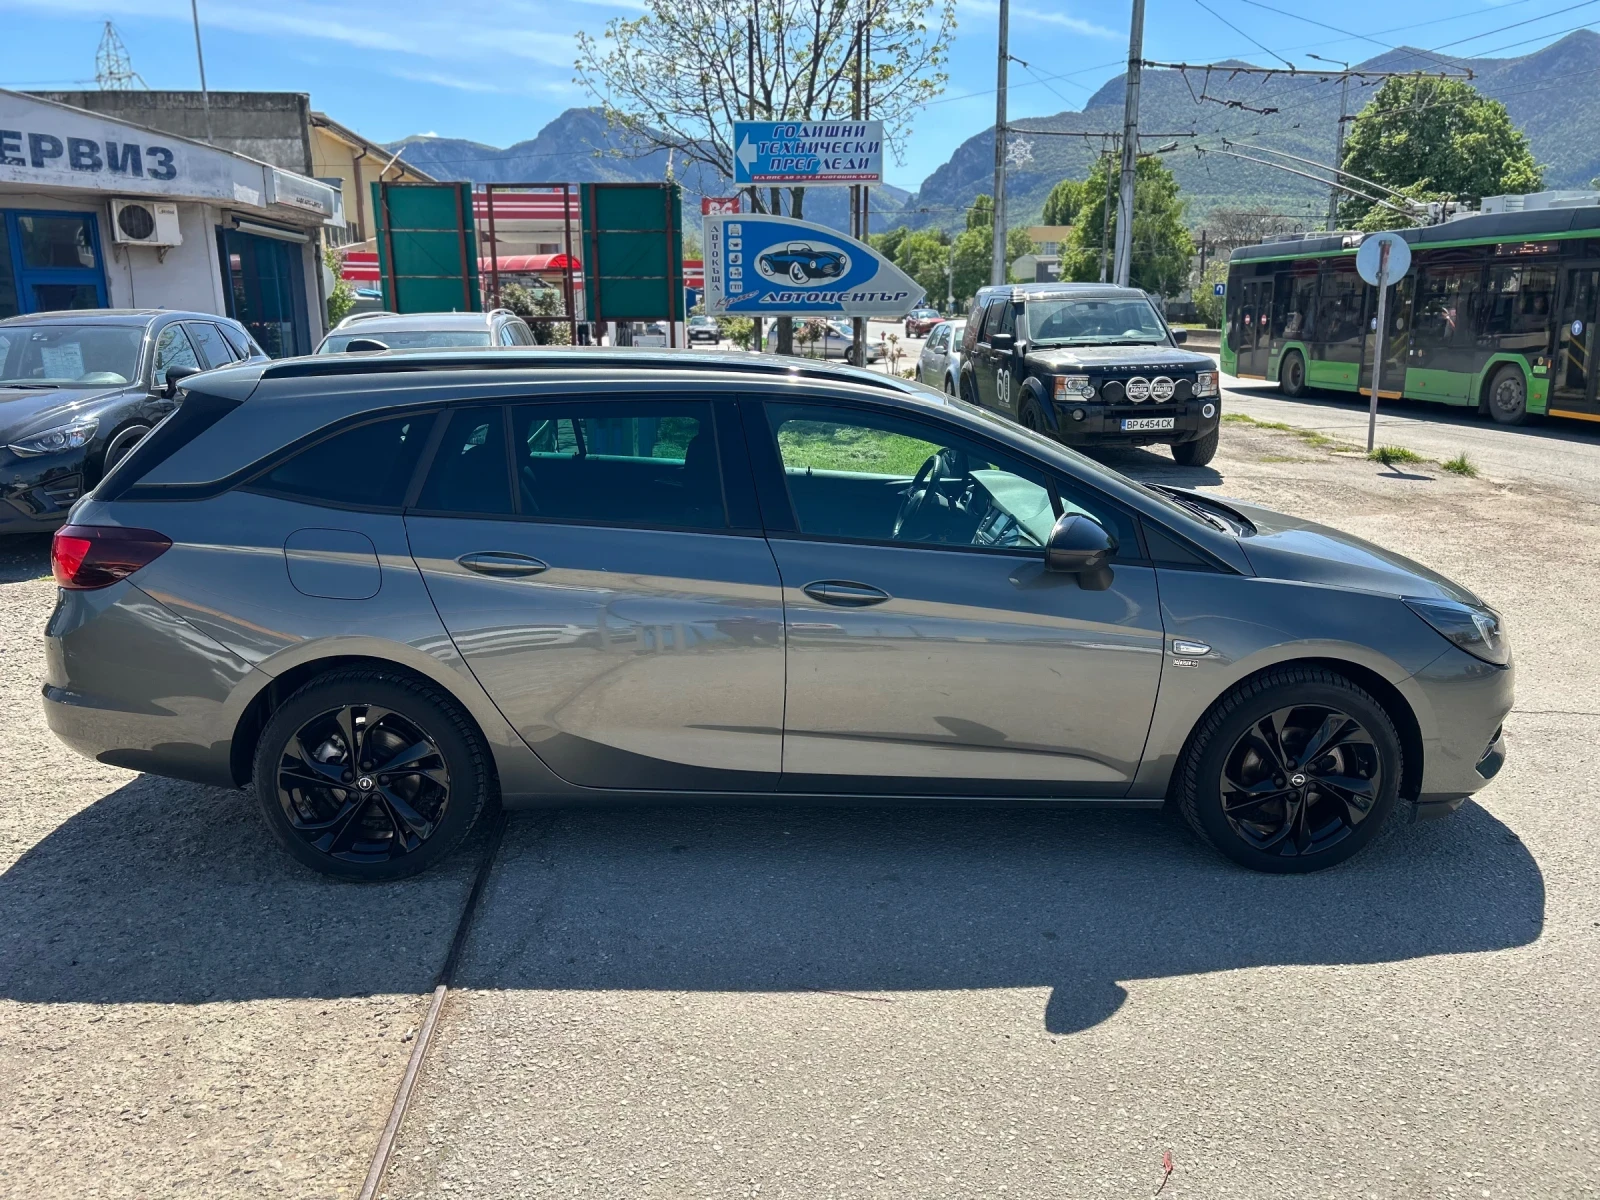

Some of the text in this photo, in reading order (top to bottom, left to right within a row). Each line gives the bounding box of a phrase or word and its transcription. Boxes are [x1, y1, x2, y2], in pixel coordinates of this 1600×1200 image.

[773, 125, 866, 138] ГОДИШНИ
[759, 141, 880, 154] ТЕХНИЧЕСКИ
[770, 157, 870, 170] ПРЕГЛЕДИ
[711, 225, 720, 291] АВТОКЪЩА
[759, 291, 908, 303] АВТОЦЕНТЪР
[996, 368, 1010, 402] 60
[1126, 418, 1173, 430] BP 6454 CK
